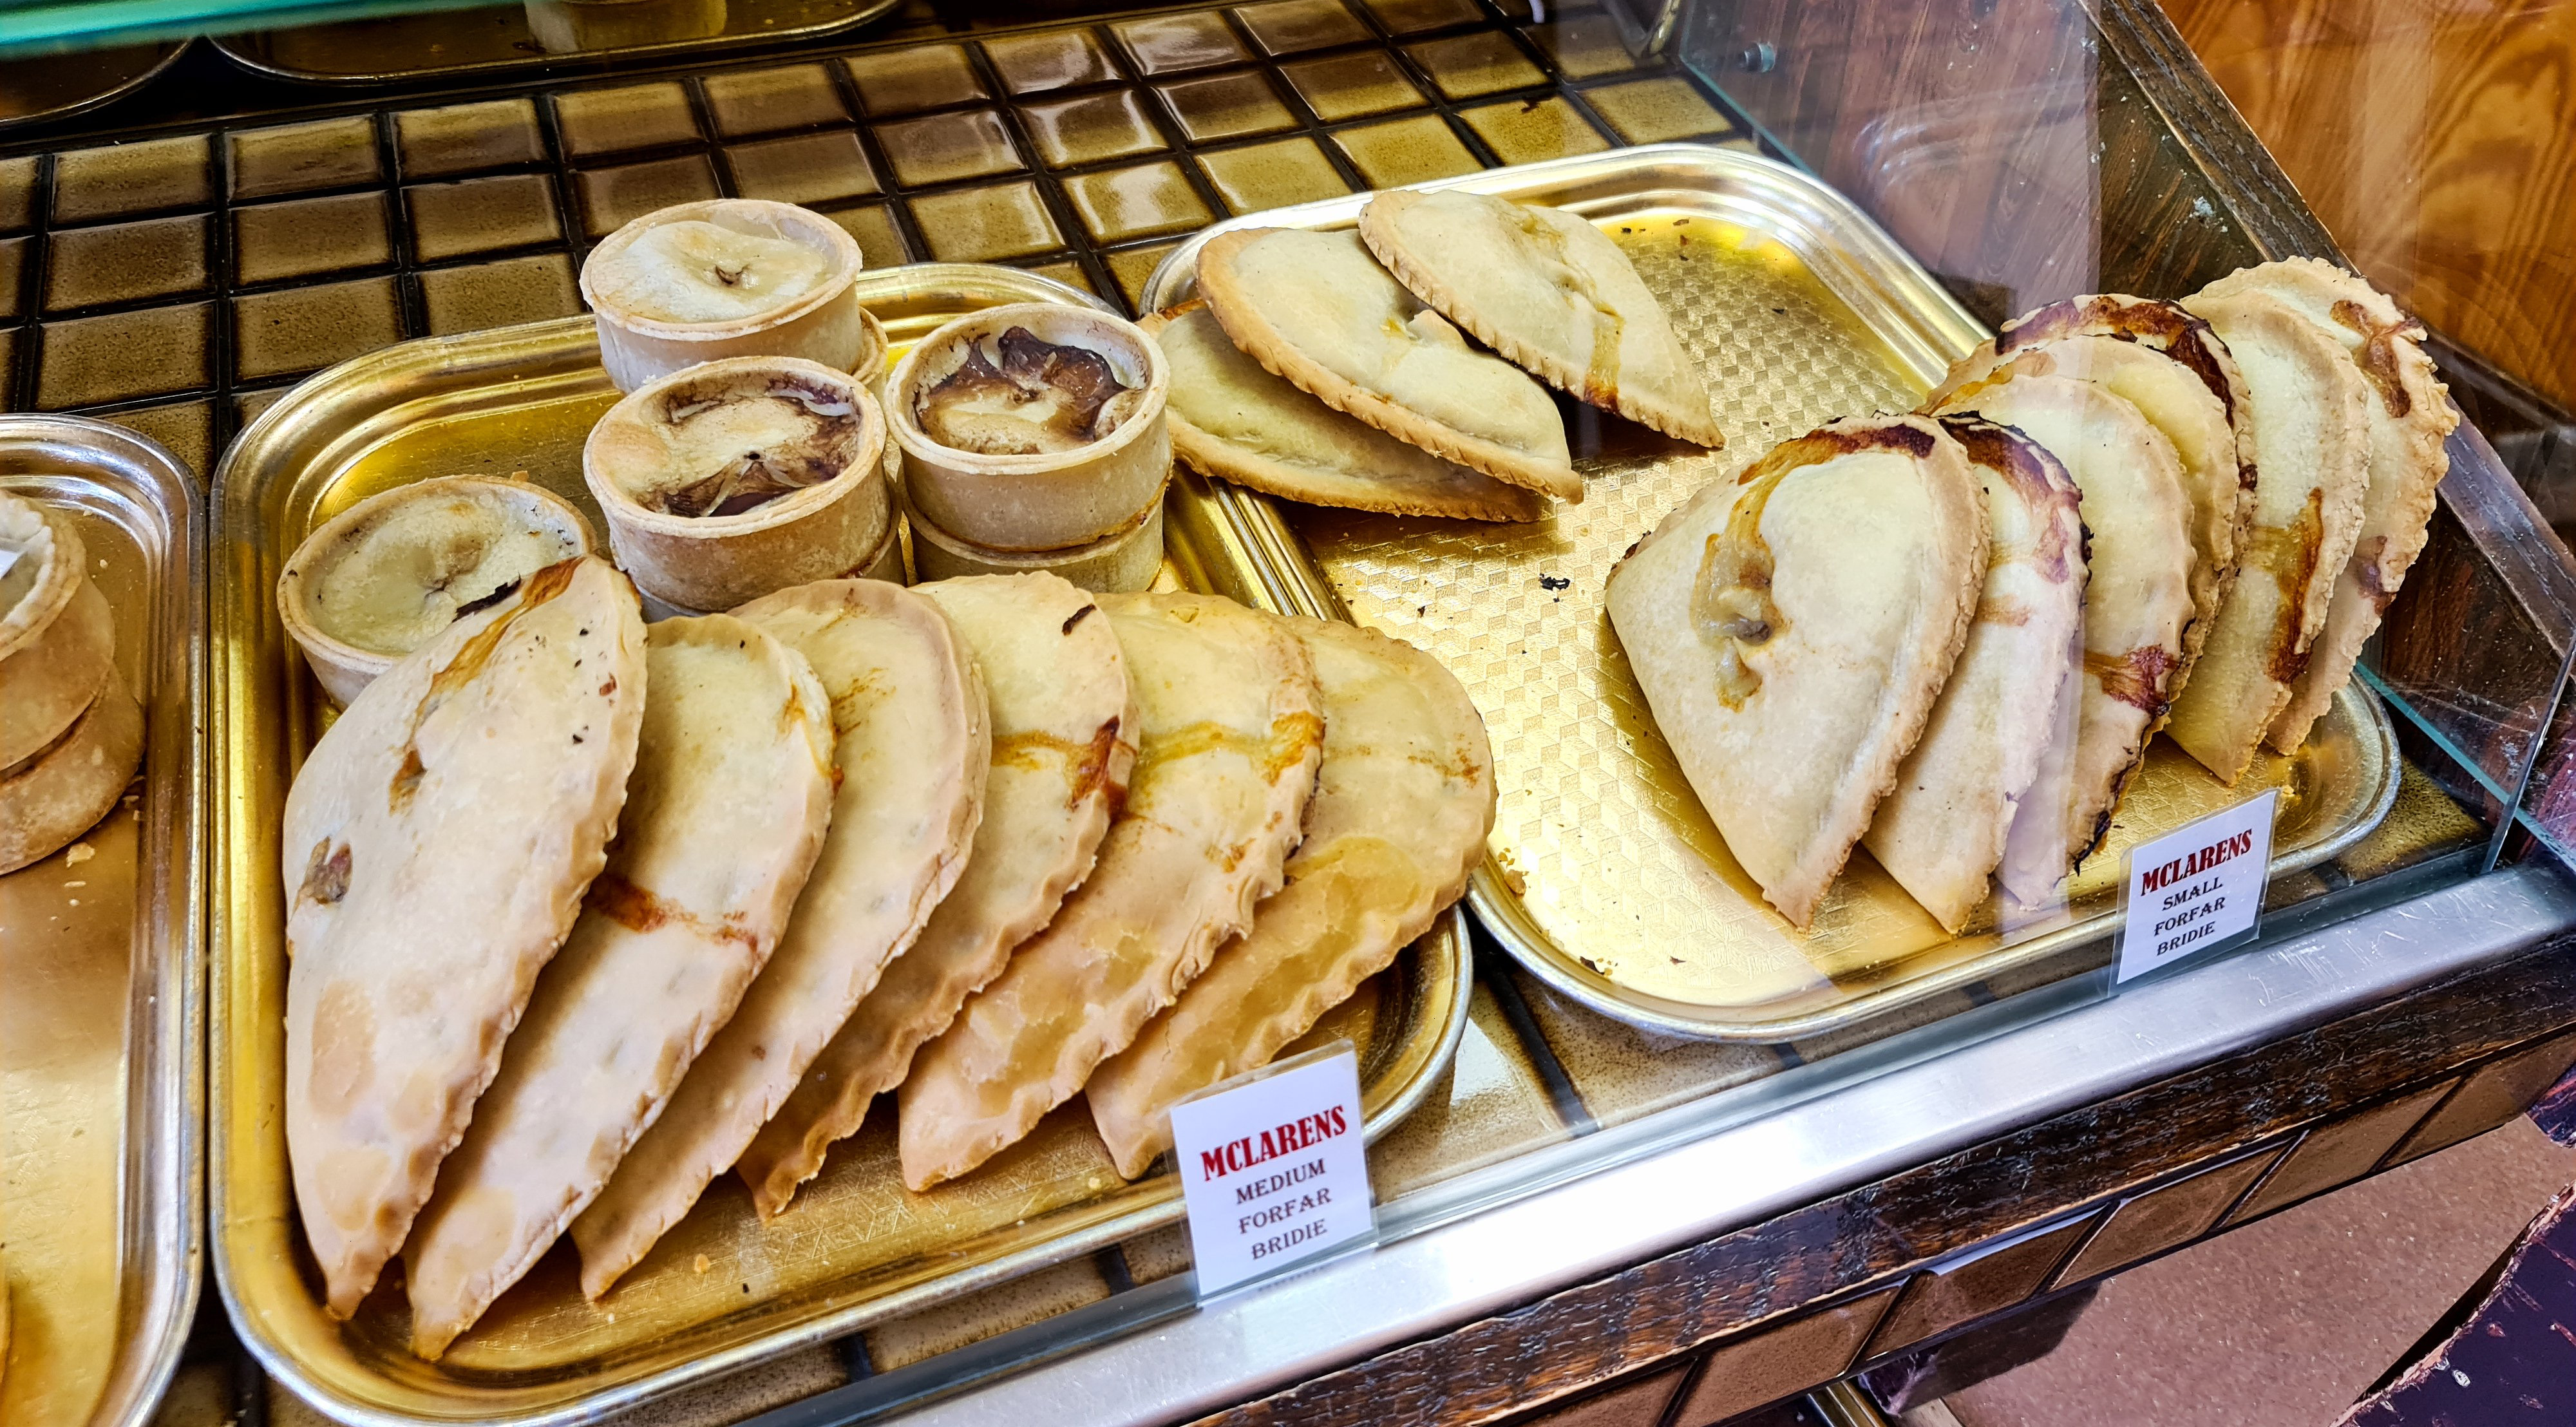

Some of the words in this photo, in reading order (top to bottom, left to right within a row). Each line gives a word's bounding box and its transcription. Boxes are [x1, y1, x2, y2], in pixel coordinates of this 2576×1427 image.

[2141, 828, 2252, 896] MCLARENS
[2162, 876, 2223, 911] SMALL
[2154, 896, 2226, 936] FORFAR
[2157, 921, 2215, 956] BRIDIE
[1200, 1104, 1347, 1181] MCLARENS
[1236, 1158, 1327, 1205] MEDIUM
[1239, 1187, 1332, 1234] FORFAR
[1251, 1218, 1327, 1260] BRIDIE
